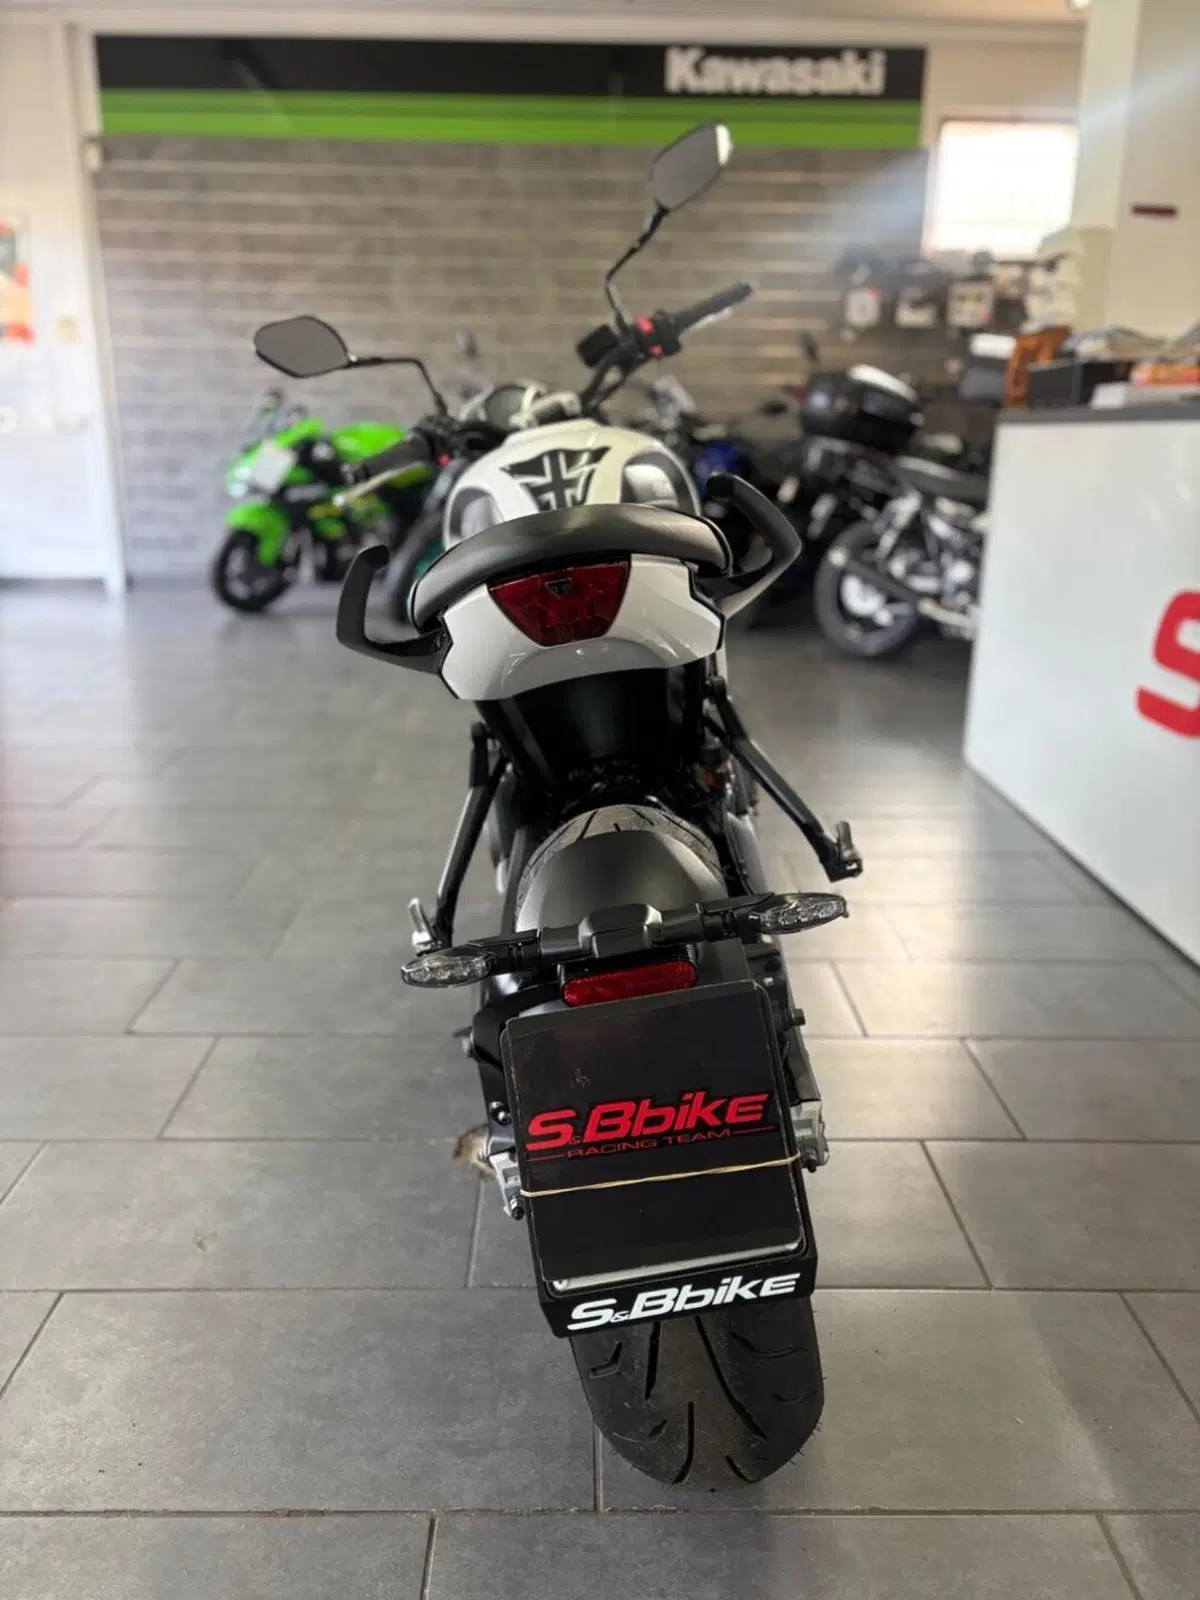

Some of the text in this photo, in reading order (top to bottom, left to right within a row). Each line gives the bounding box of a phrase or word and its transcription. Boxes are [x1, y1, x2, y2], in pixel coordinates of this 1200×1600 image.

[664, 46, 888, 96] Kawasaki
[567, 1128, 731, 1159] RACING TEAM
